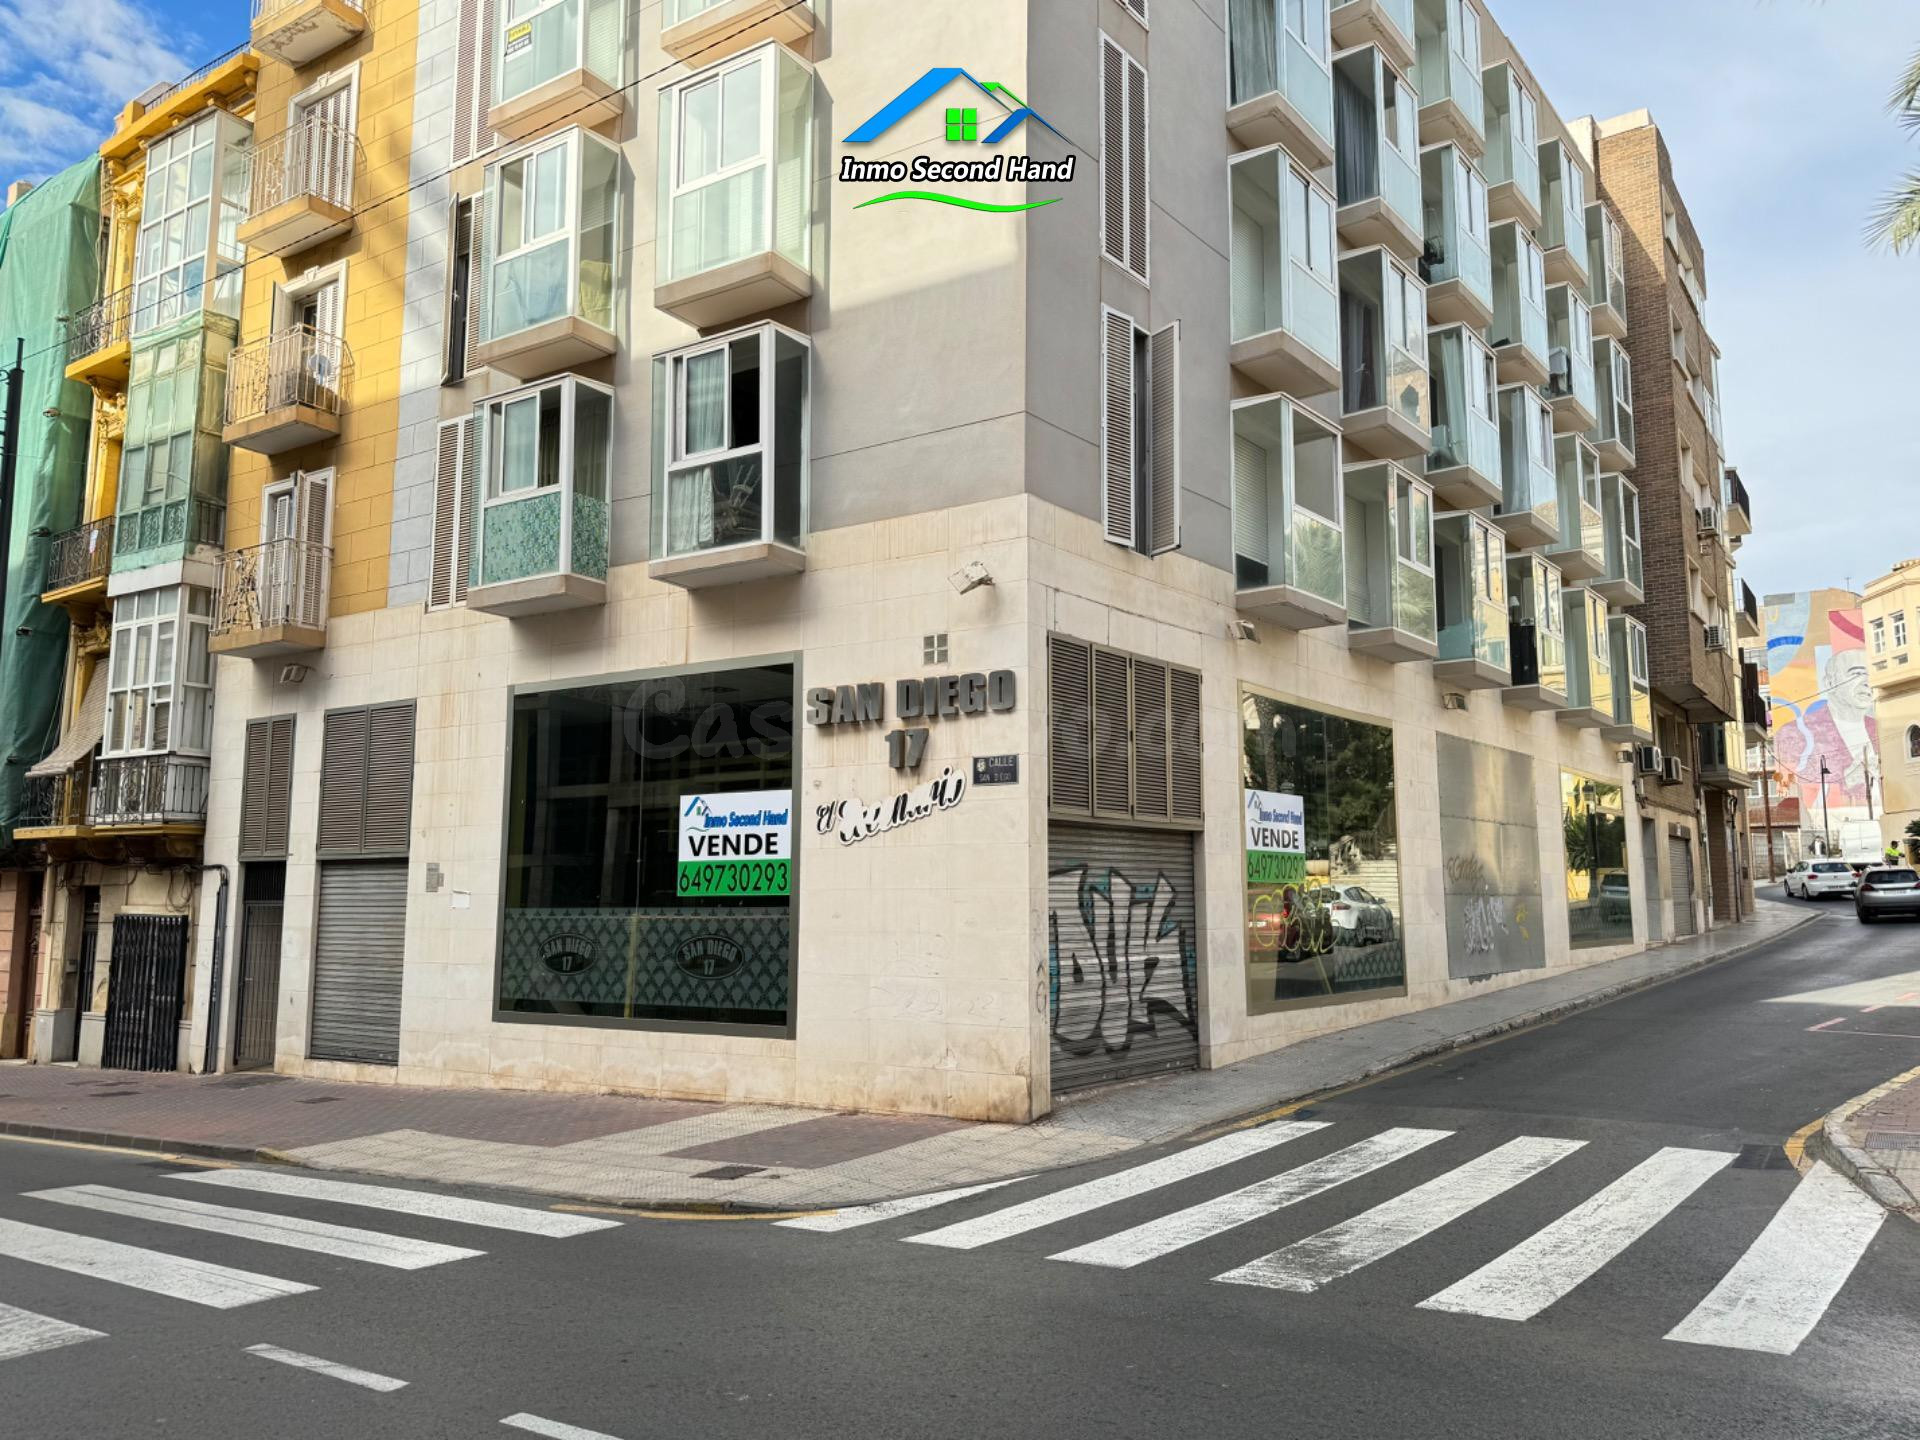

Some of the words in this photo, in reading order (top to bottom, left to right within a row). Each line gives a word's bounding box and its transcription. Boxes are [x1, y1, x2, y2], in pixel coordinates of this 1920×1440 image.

[806, 682, 884, 726] SAN
[896, 669, 1016, 719] DIEGO
[884, 728, 930, 769] 17
[988, 756, 1015, 768] CALLE
[703, 814, 727, 828] Inmo
[728, 810, 762, 827] Second
[762, 808, 789, 826] Hand
[688, 832, 779, 857] VENDE
[1250, 826, 1300, 850] VENDE
[679, 862, 789, 893] 649730293
[1247, 853, 1305, 880] 649730293
[682, 940, 704, 961] SAN
[706, 939, 739, 963] DIEGO
